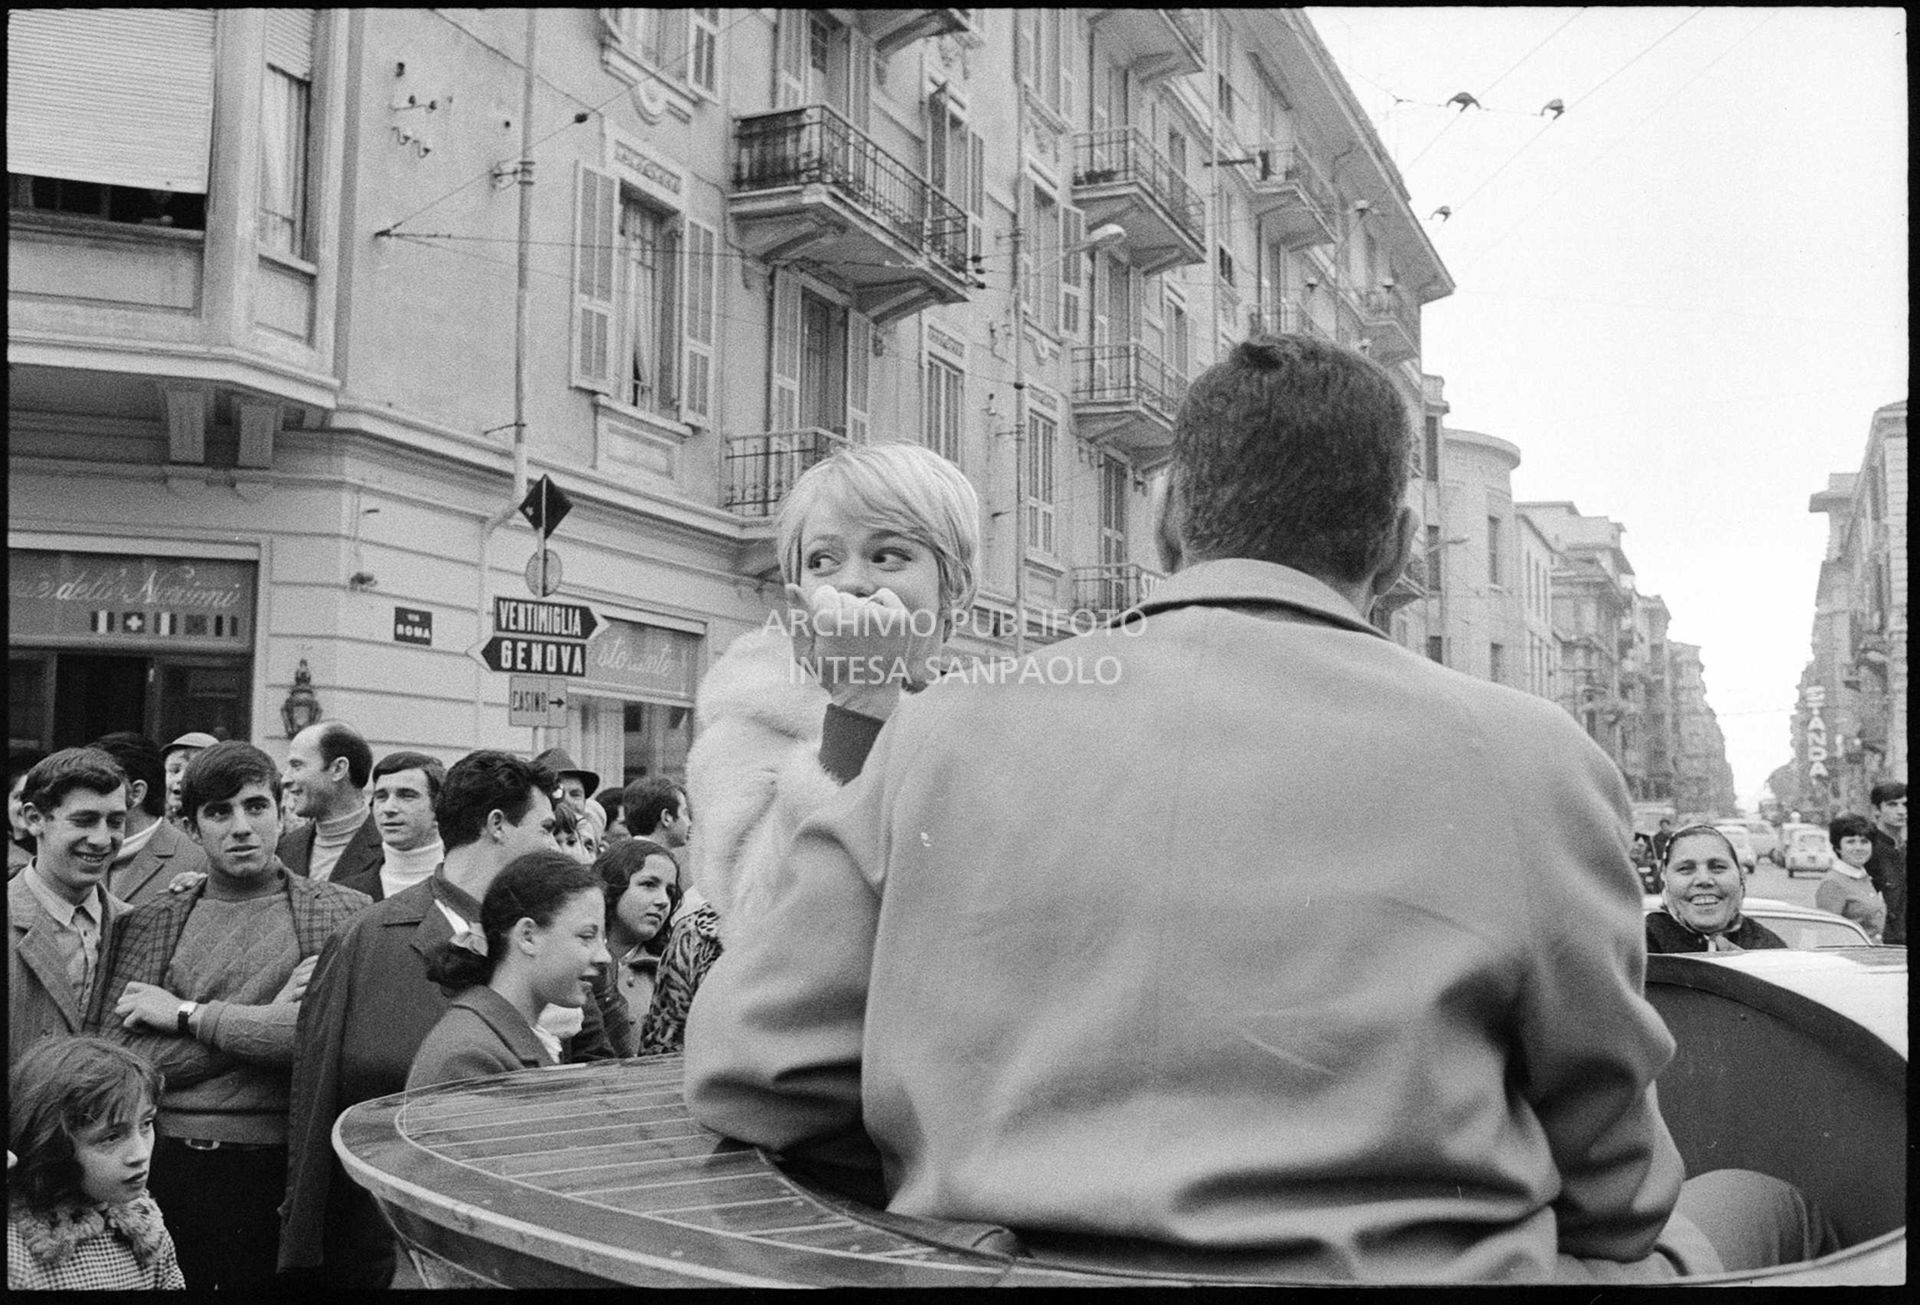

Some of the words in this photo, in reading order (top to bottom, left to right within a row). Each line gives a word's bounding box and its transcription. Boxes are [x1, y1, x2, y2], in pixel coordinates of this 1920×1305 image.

[396, 623, 431, 639] ROMA
[499, 600, 581, 636] VENTIMIGLIA
[501, 640, 583, 674] GENOVA
[513, 690, 547, 713] CASINO
